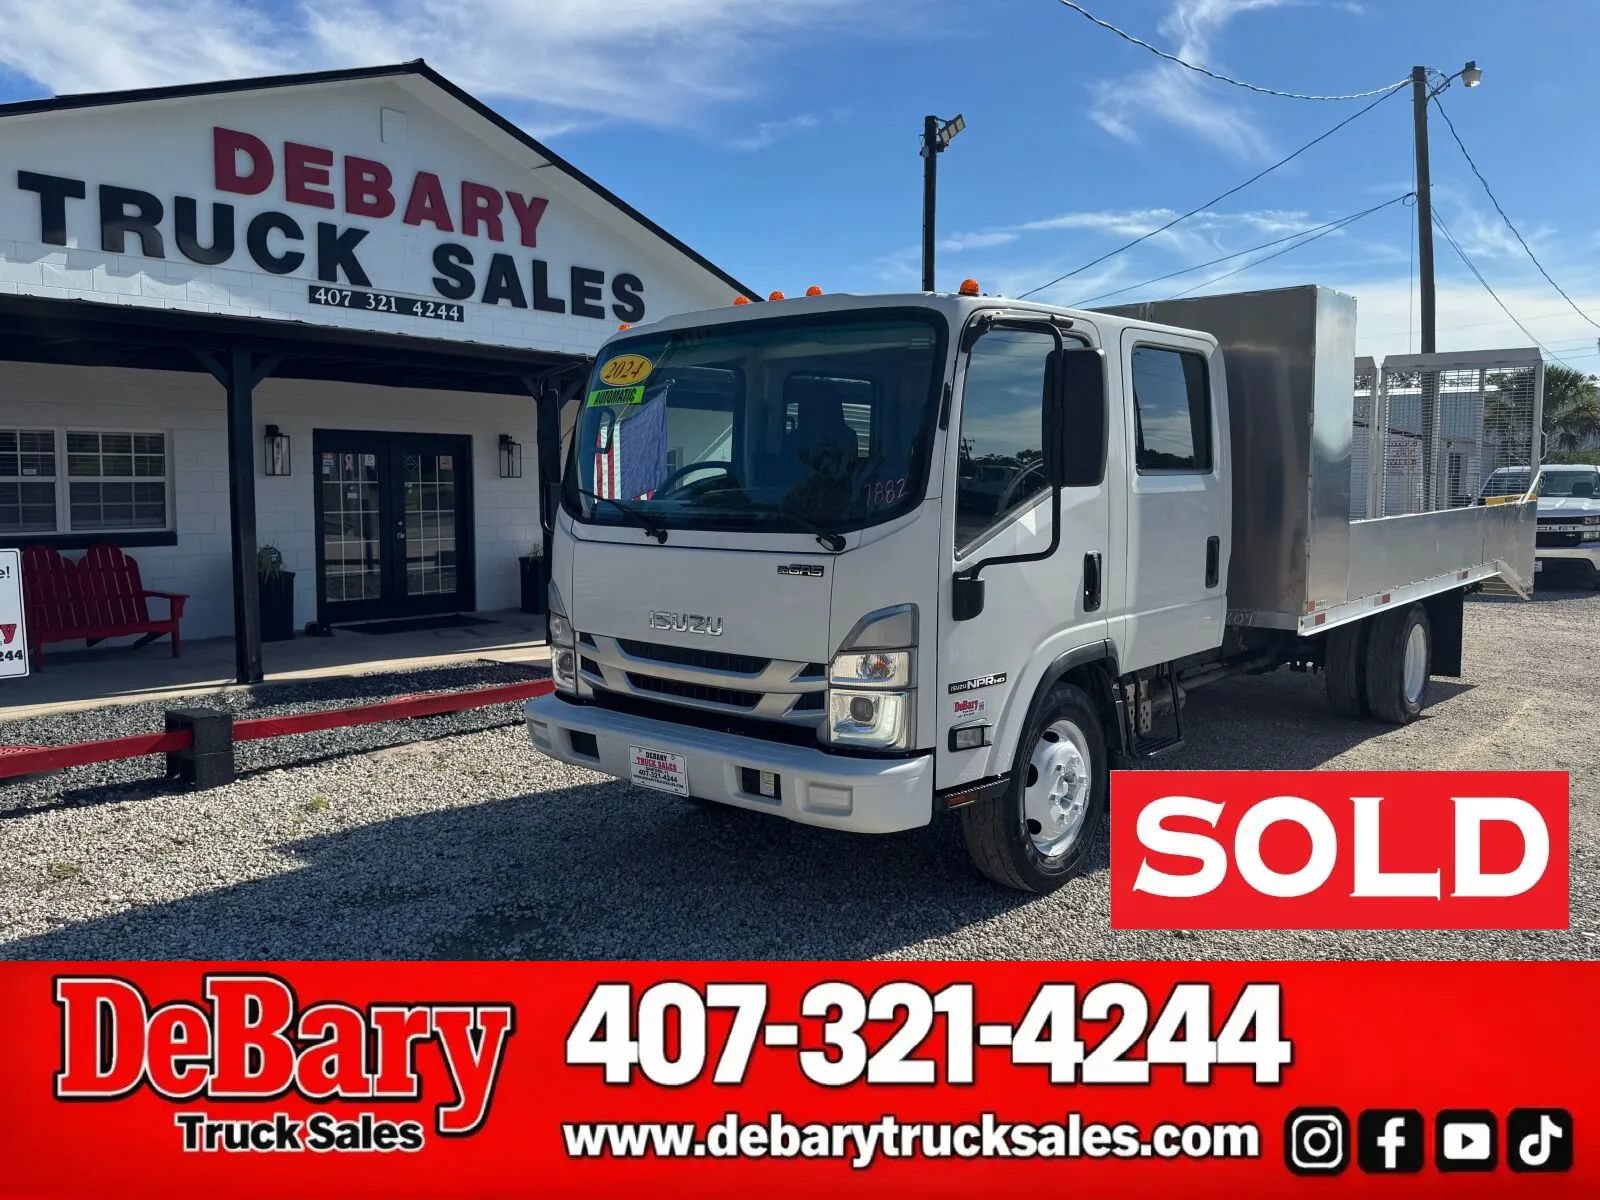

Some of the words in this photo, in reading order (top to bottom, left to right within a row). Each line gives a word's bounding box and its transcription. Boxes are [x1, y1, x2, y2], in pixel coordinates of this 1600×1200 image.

[213, 126, 548, 248] DEBARY
[17, 169, 372, 288] TRUCK
[432, 242, 645, 323] SALES
[315, 287, 351, 306] 407
[365, 293, 398, 312] 321
[413, 300, 460, 321] 4244
[604, 360, 646, 379] 2024
[593, 387, 638, 406] AUTOMATIC
[648, 609, 724, 637] ISUZU
[950, 683, 967, 692] ISUZU
[636, 756, 657, 768] TRUCK
[657, 760, 677, 772] SALES
[645, 751, 668, 761] DEBARY
[638, 769, 678, 783] 407-321-4244
